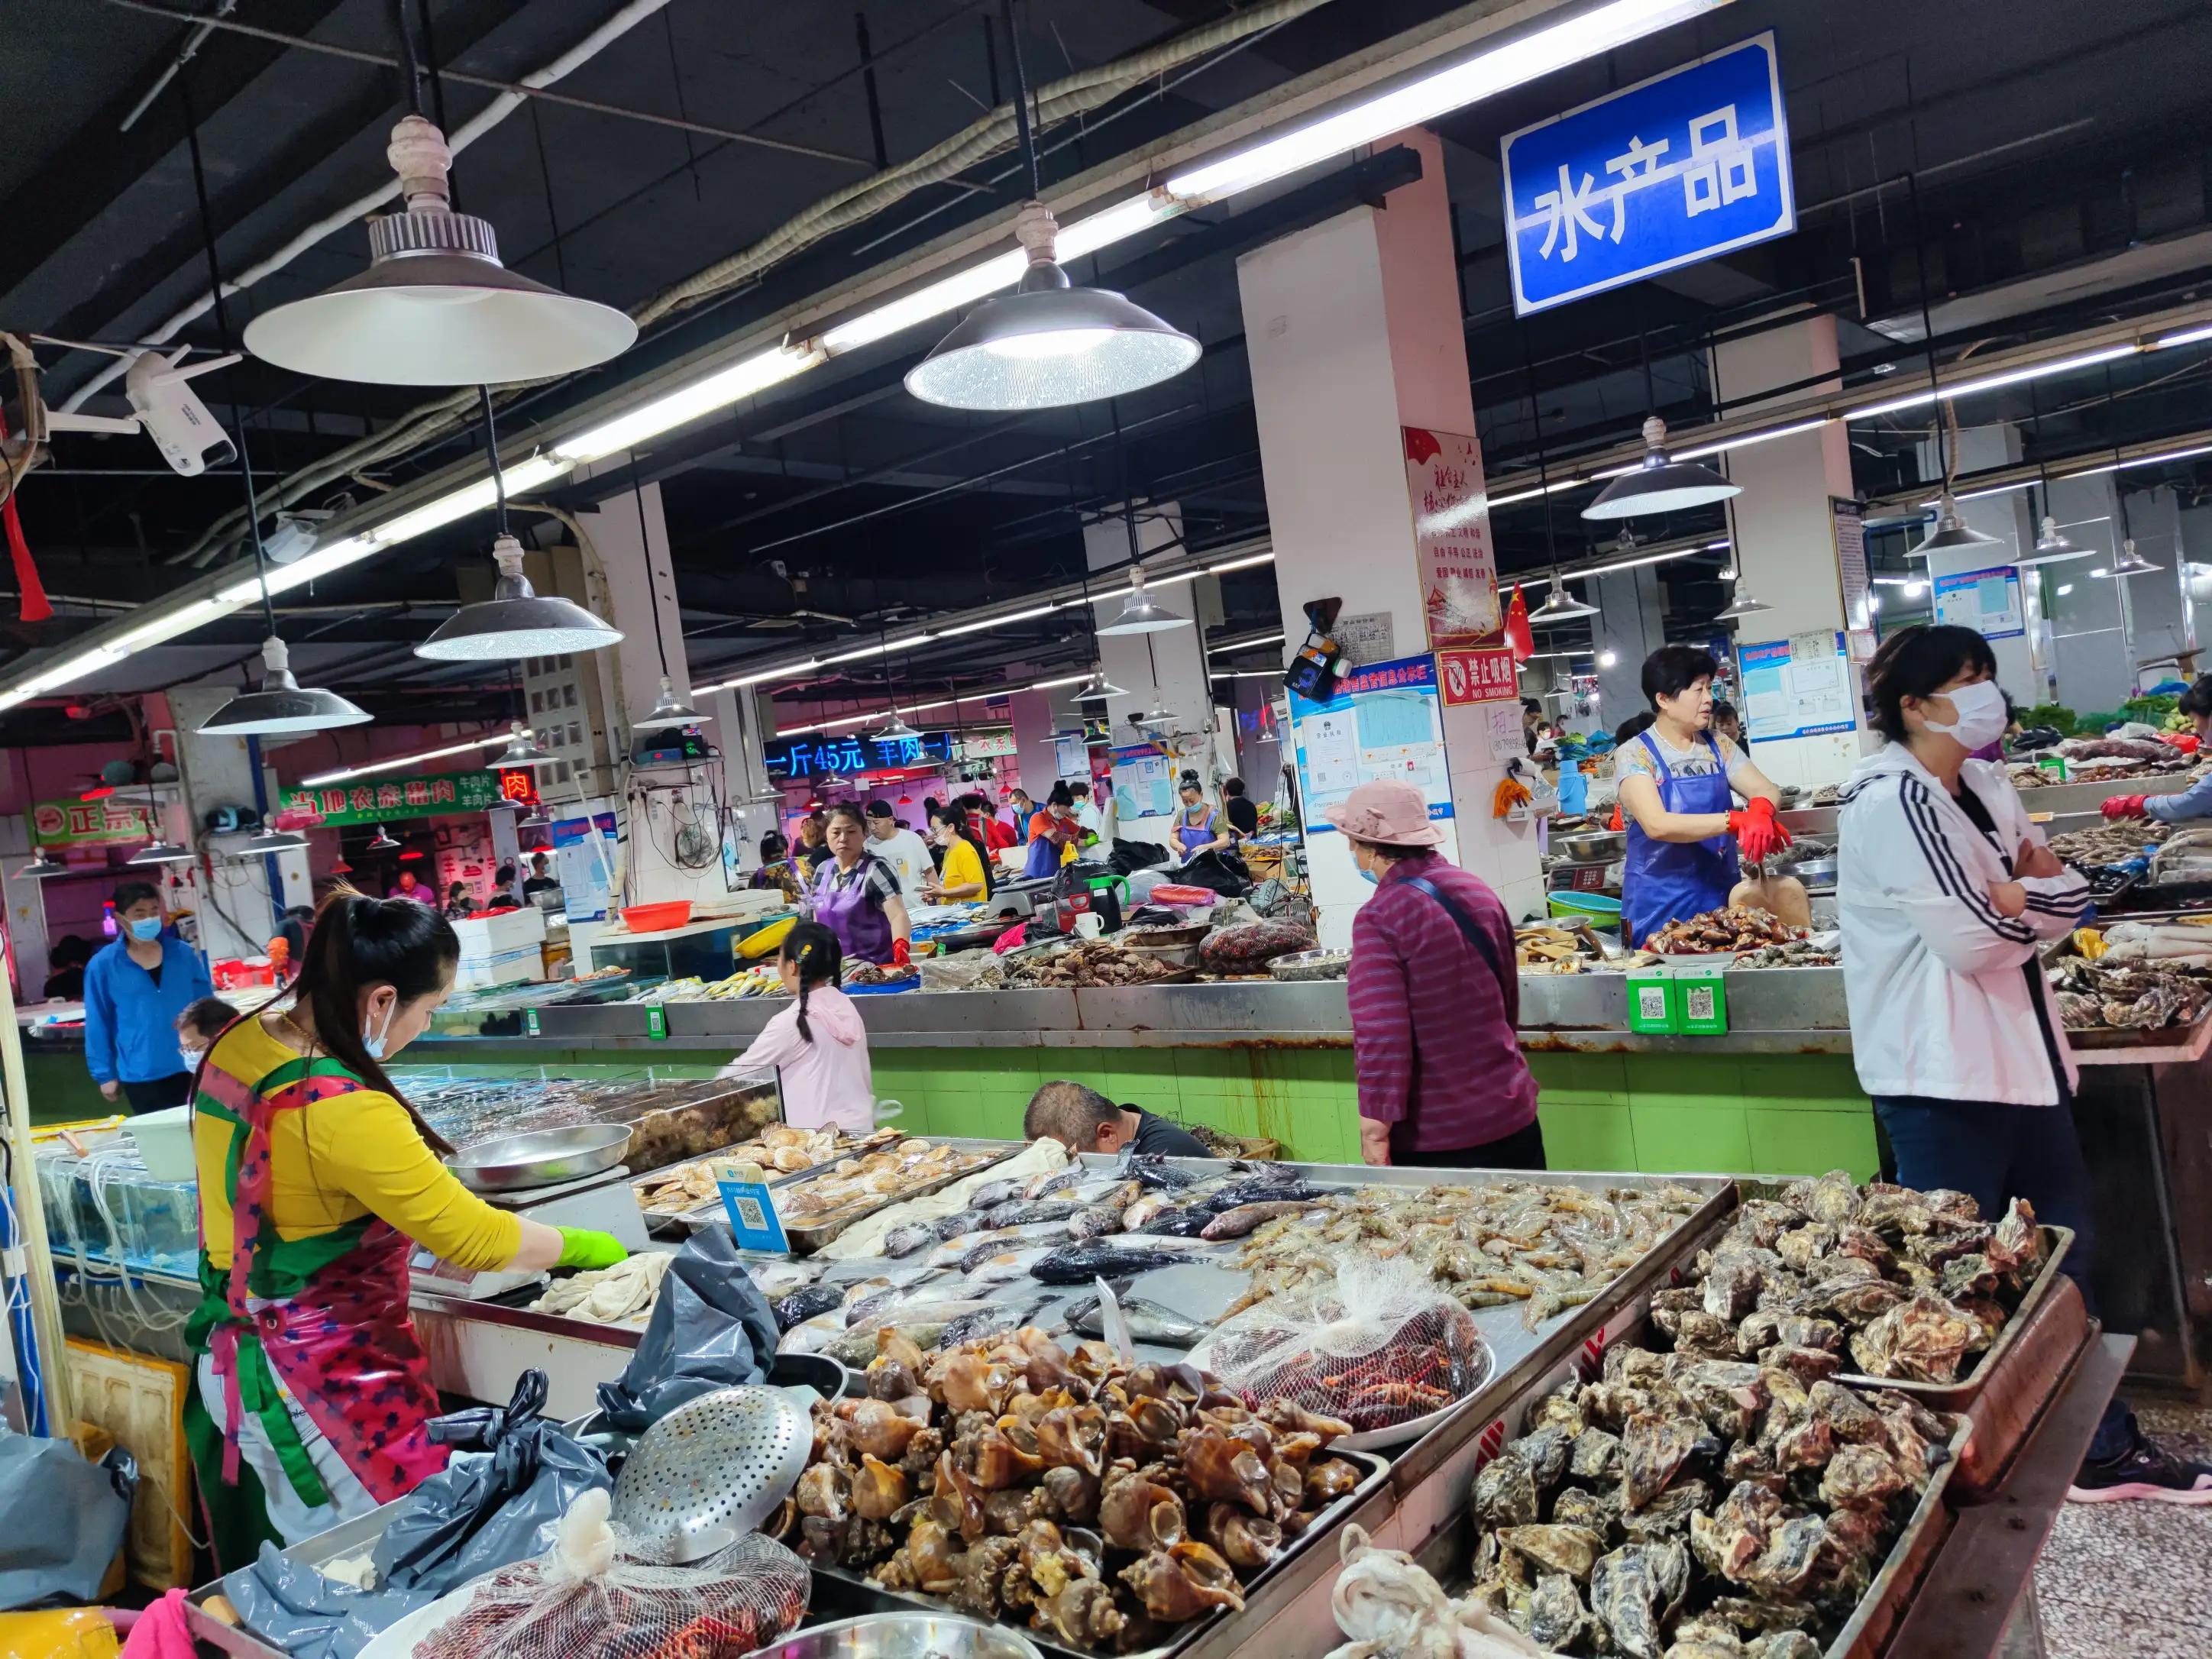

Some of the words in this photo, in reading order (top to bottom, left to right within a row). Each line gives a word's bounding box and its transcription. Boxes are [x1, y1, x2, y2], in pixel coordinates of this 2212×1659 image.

[1534, 104, 1757, 263] 水产品
[1468, 656, 1512, 686] 禁止吸烟
[1473, 689, 1482, 698] NO
[1485, 686, 1513, 697] SMOKING
[765, 740, 865, 777] 一斤45元
[290, 778, 455, 818] 当地农家猪肉
[505, 772, 528, 798] 肉
